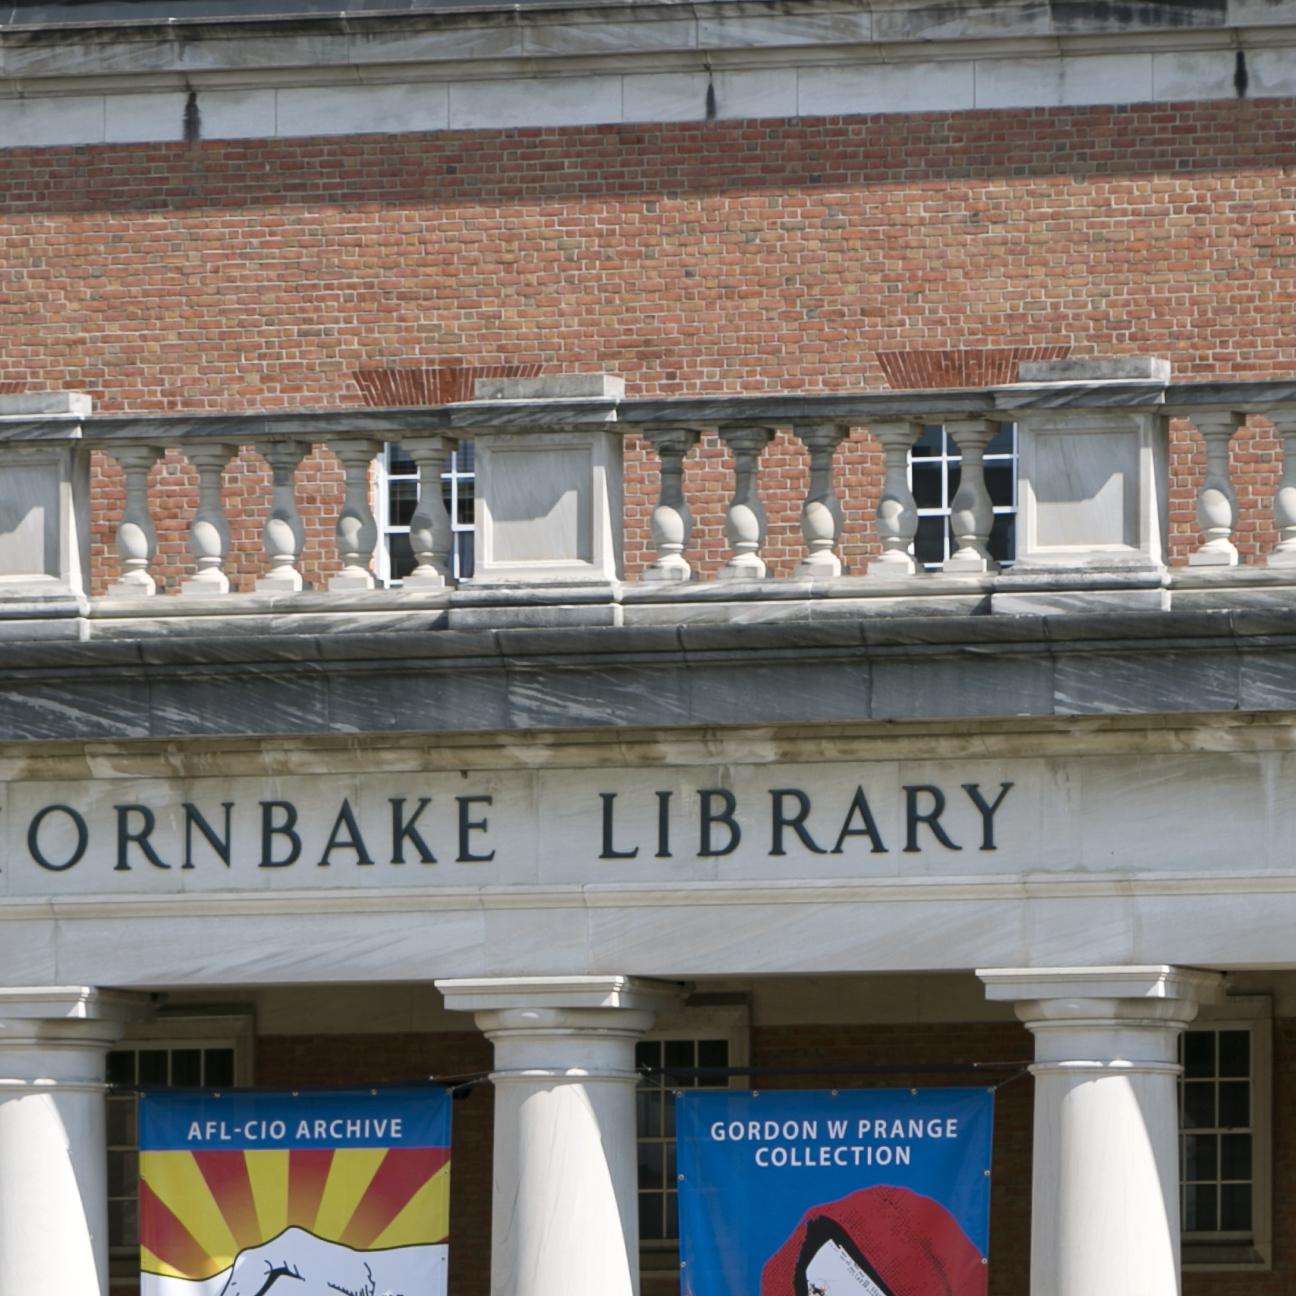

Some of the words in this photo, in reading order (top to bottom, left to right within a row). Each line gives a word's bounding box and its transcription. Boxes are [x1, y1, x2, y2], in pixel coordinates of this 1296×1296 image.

[597, 781, 1015, 859] LIBRARY
[187, 1120, 287, 1141] AFL-CIO
[295, 1118, 403, 1140] ARCHIVE
[710, 1120, 818, 1142] GORDON
[827, 1120, 849, 1140] W
[857, 1118, 959, 1140] PRANGE
[754, 1146, 912, 1168] COLLECTION
